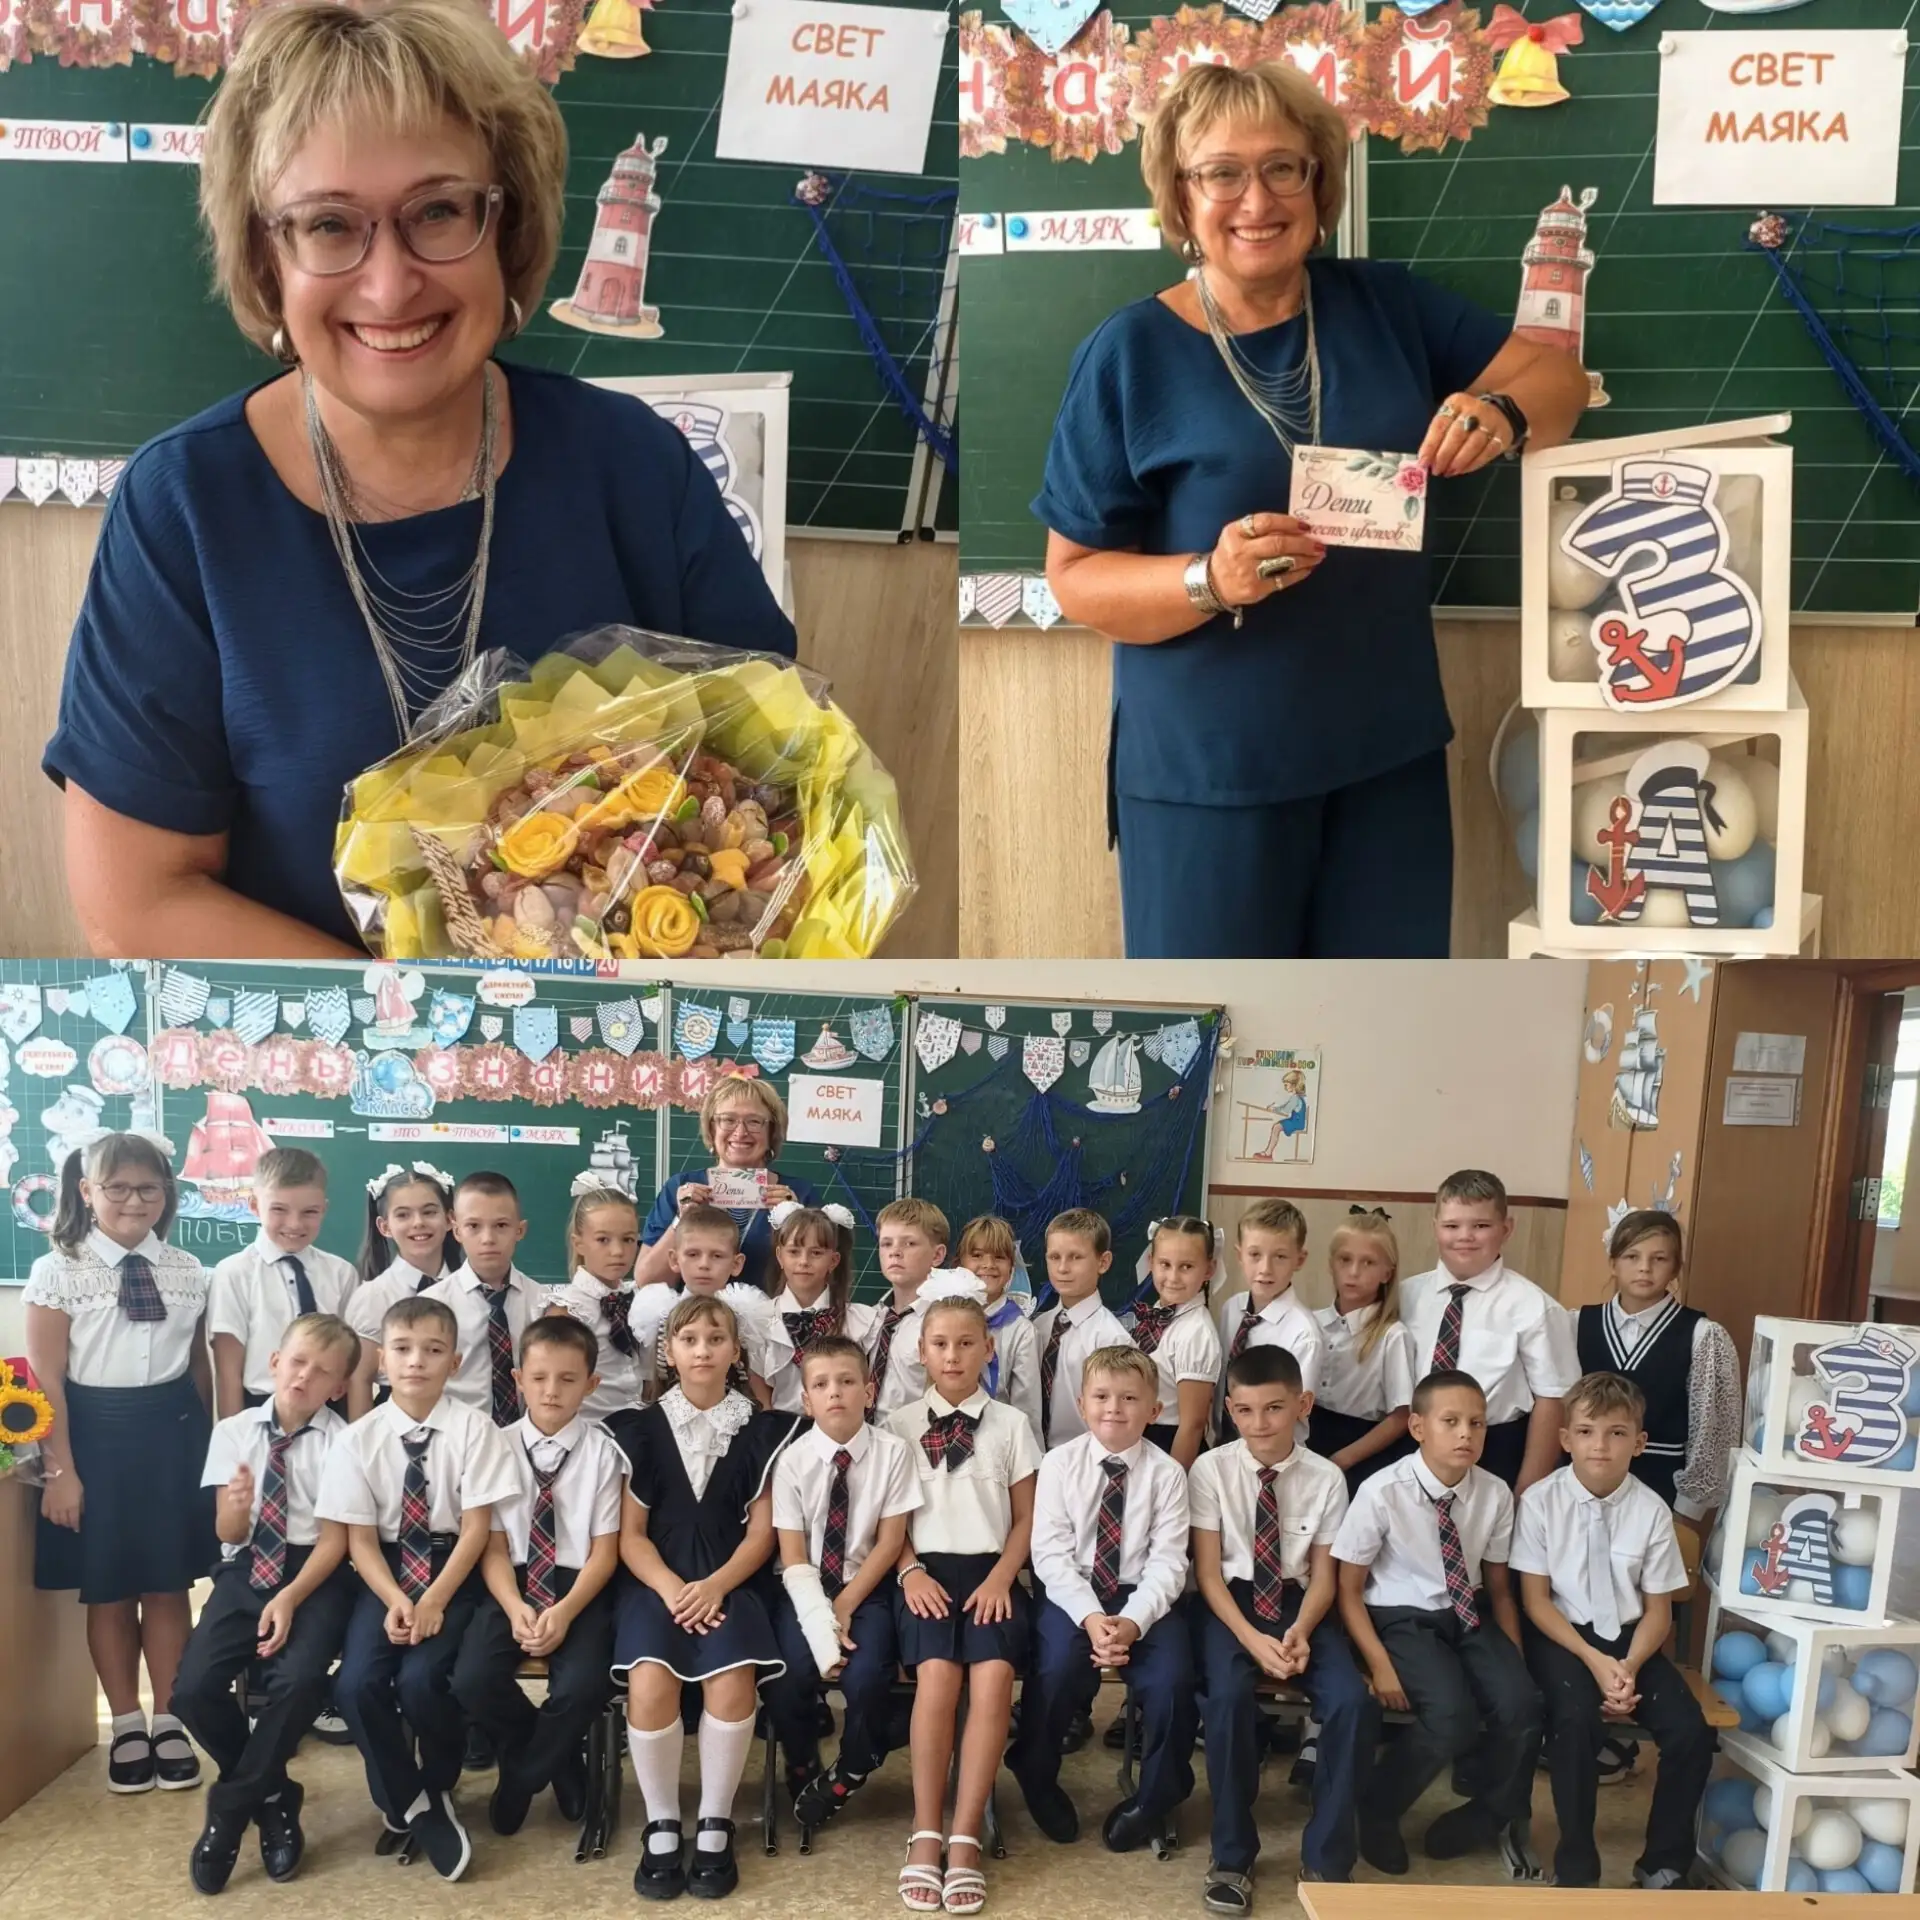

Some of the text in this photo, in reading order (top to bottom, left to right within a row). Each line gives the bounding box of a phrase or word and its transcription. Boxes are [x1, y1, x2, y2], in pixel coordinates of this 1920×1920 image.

[791, 22, 885, 57] СВЕТ
[1729, 52, 1835, 87] СВЕТ
[765, 74, 889, 113] МАЯКА
[14, 126, 105, 153] ТВОЙ
[1705, 110, 1849, 143] МАЯКА
[1039, 215, 1134, 245] МАЯК
[1301, 468, 1373, 515] Дети
[598, 959, 618, 972] 20
[163, 1035, 337, 1078] День
[816, 1085, 857, 1099] СВЕТ
[368, 1102, 418, 1116] КЛАСС
[806, 1107, 863, 1122] МАЯКА
[525, 1128, 568, 1142] МАЯК
